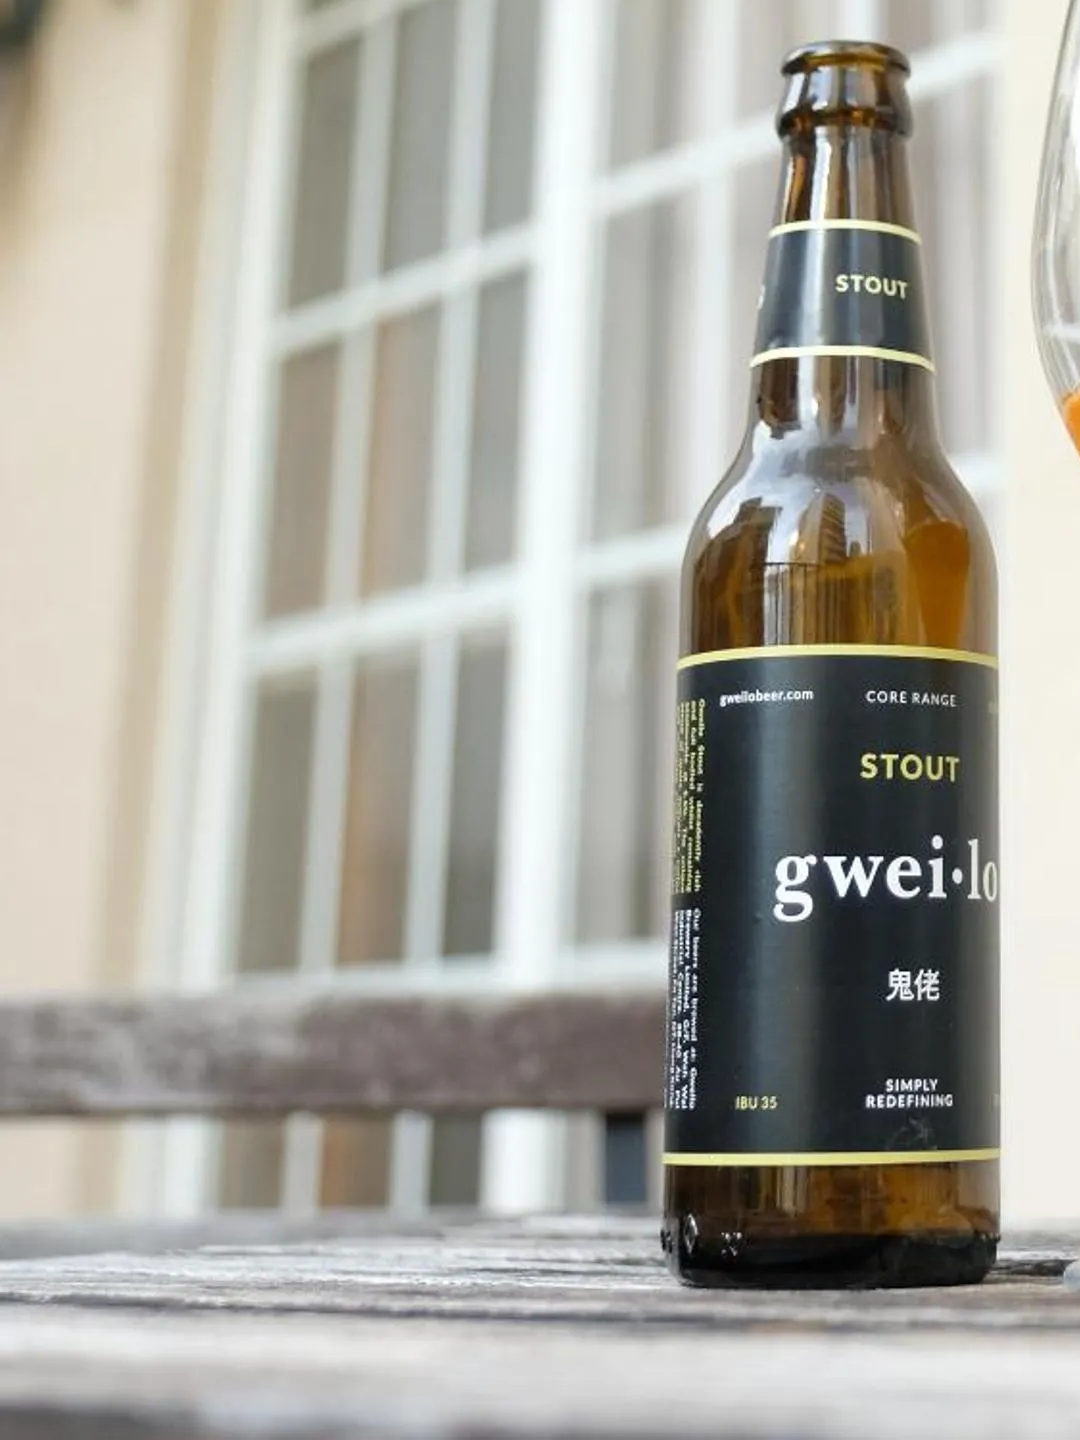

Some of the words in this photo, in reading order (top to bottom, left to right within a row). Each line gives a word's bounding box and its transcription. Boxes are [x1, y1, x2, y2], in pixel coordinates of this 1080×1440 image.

[835, 273, 908, 299] STOUT
[719, 688, 814, 708] gweilobeer.com
[865, 690, 907, 705] CORE
[911, 692, 957, 708] RANGE
[860, 753, 960, 782] STOUT
[886, 968, 940, 1001] 鬼佬
[885, 1078, 939, 1092] SIMPLY
[735, 1096, 758, 1110] IBU
[760, 1096, 778, 1109] 35
[865, 1094, 954, 1109] REDEFINING
